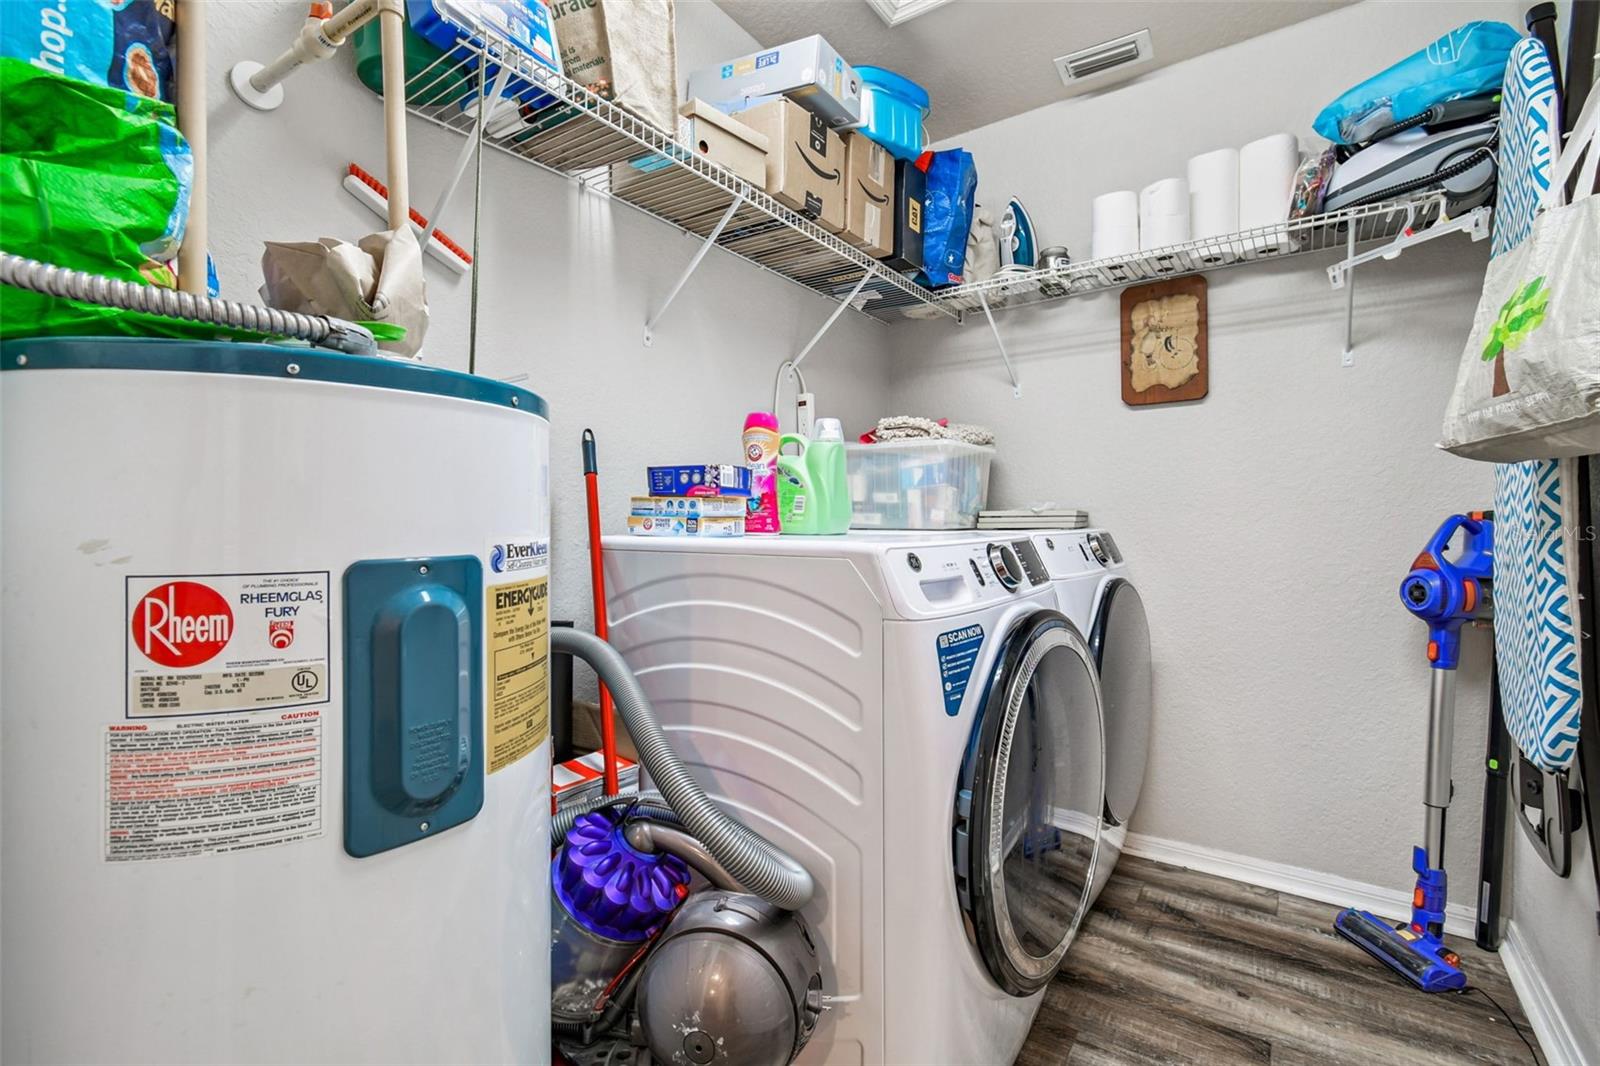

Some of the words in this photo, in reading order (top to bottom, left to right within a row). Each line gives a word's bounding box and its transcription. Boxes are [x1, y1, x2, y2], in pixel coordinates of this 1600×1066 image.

[240, 590, 323, 604] RHEEMGLAS
[496, 582, 548, 609] ENERGYGUIDE
[264, 606, 300, 618] FURY
[144, 585, 229, 656] Rheem
[948, 630, 967, 643] SCAN
[967, 626, 982, 637] NOW
[280, 711, 320, 720] CAUTION
